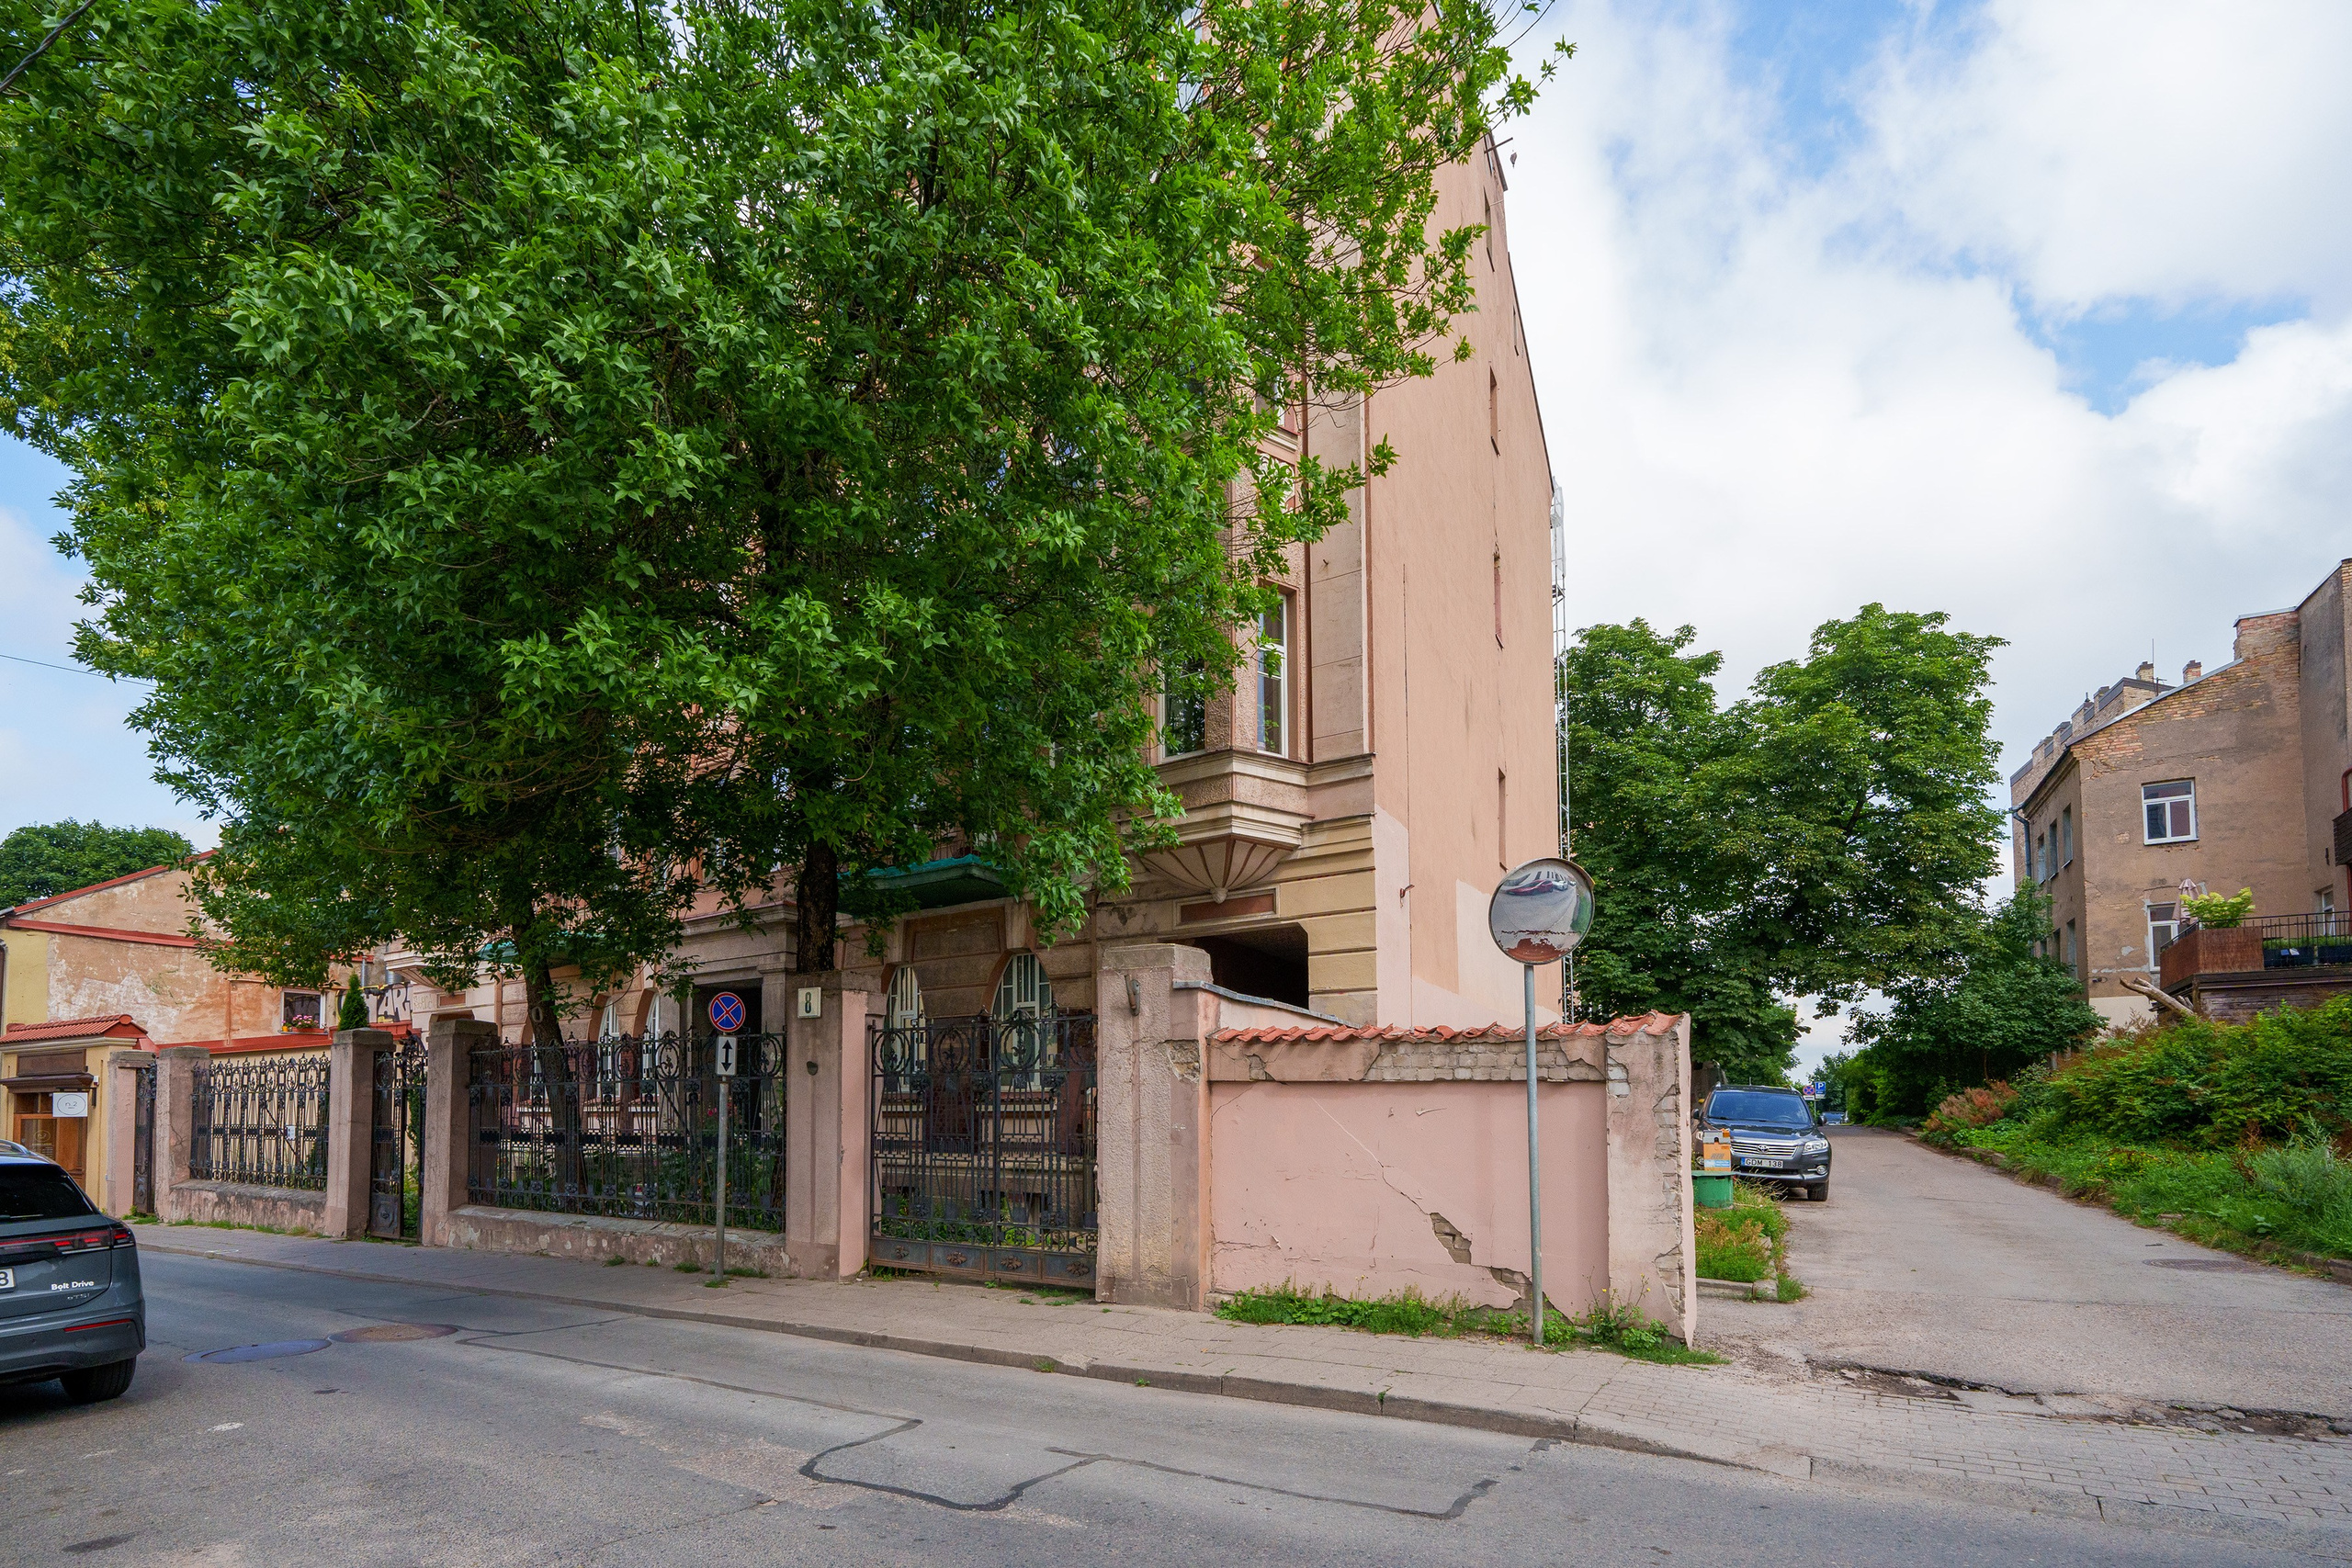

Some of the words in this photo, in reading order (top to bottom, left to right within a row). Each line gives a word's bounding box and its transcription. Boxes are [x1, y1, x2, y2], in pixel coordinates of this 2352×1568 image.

[805, 992, 812, 1014] 8
[1746, 1158, 1763, 1167] GDM
[51, 1283, 69, 1292] Bolt
